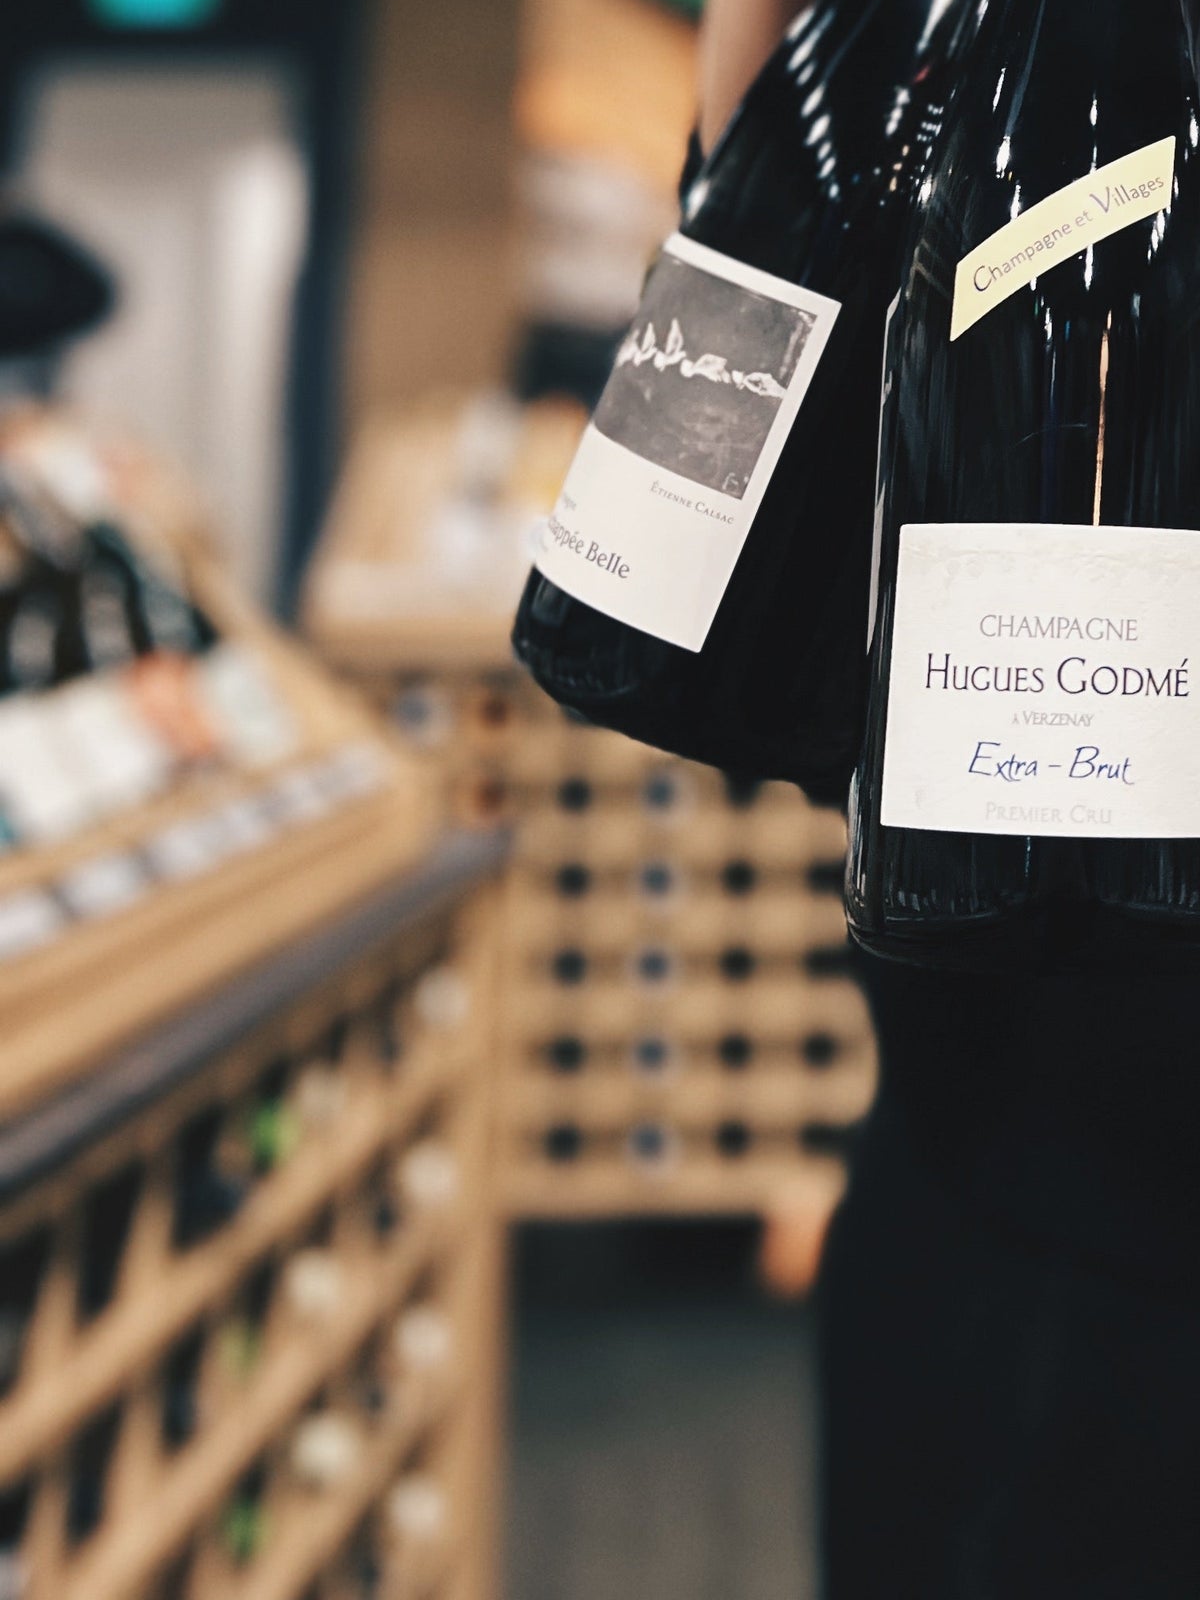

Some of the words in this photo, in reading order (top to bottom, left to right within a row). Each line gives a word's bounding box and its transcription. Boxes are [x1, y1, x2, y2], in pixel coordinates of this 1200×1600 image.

[973, 223, 1072, 292] Champagne
[1075, 209, 1093, 228] et
[1089, 175, 1164, 213] Villages
[585, 541, 630, 579] Belle
[979, 614, 1138, 641] CHAMPAGNE
[1022, 710, 1095, 727] VERZENAY
[968, 741, 1038, 782] Extra
[1068, 745, 1135, 785] Brut
